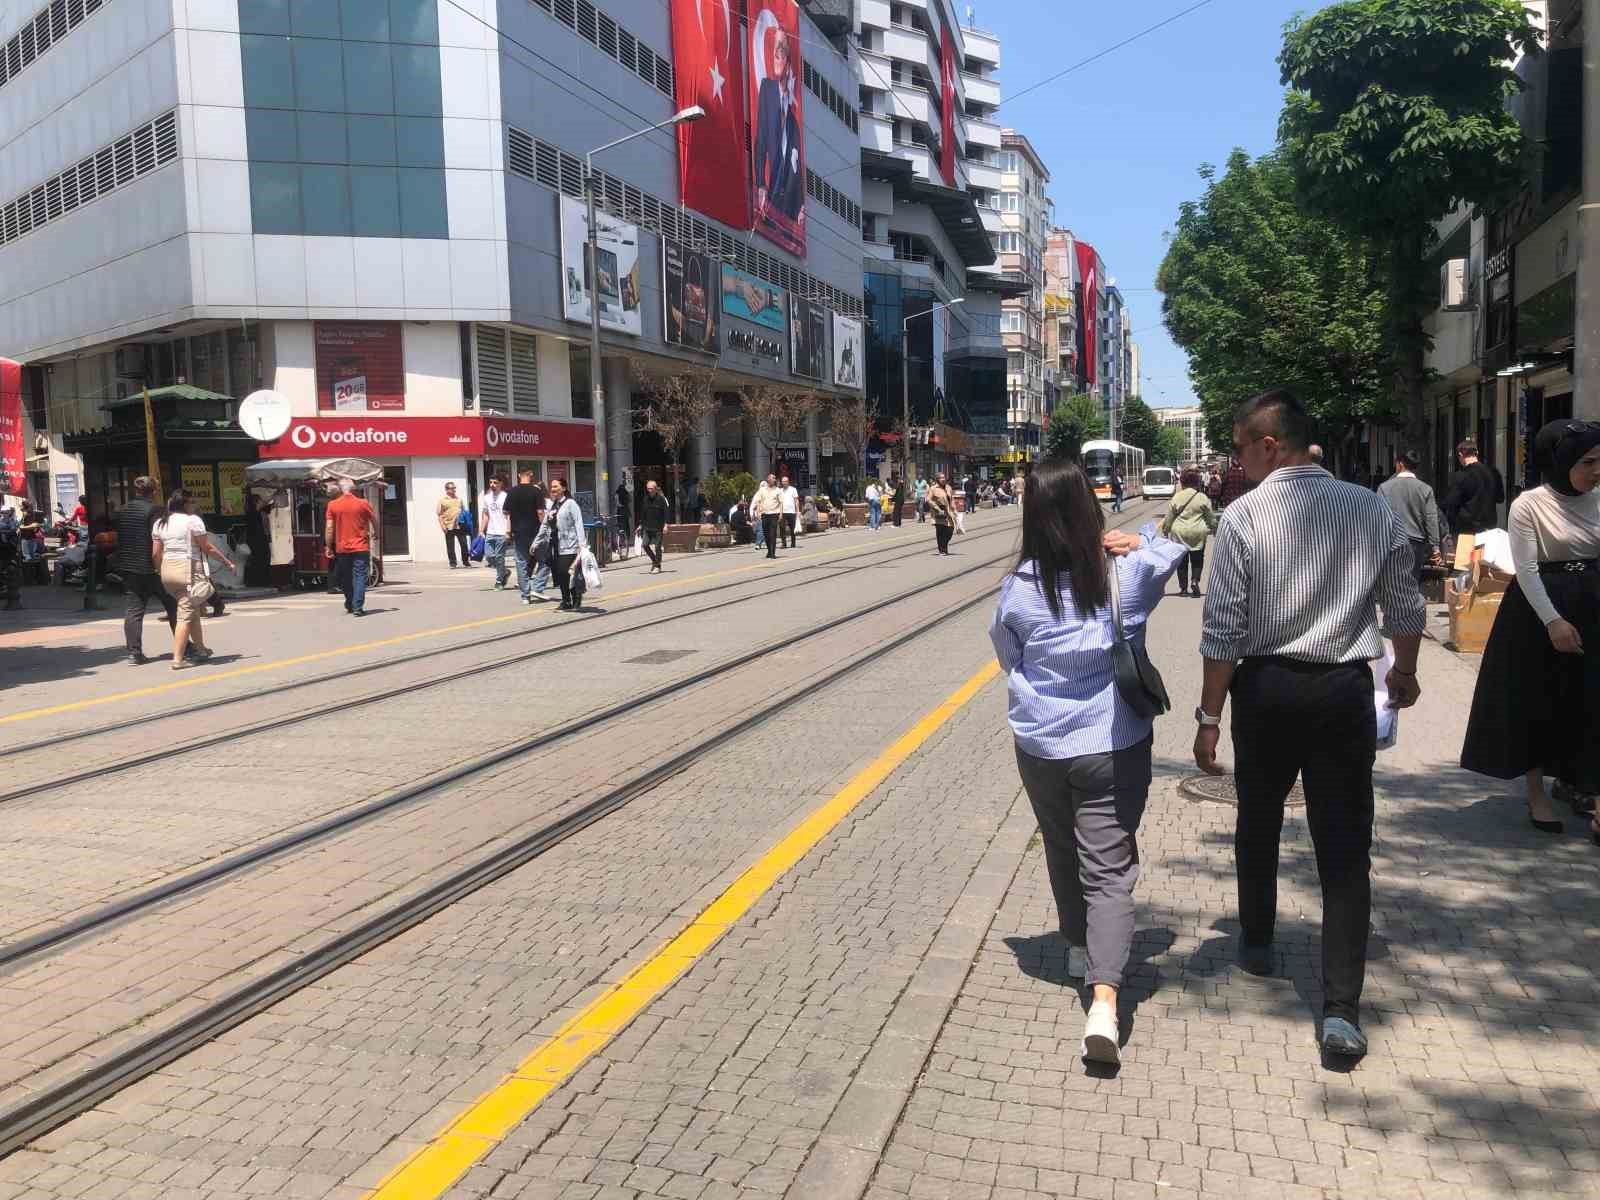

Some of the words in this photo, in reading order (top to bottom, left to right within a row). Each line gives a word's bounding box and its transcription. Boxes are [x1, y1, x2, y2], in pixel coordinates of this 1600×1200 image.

[336, 383, 353, 401] 20
[320, 427, 408, 445] vodafone
[500, 429, 539, 445] vodafone
